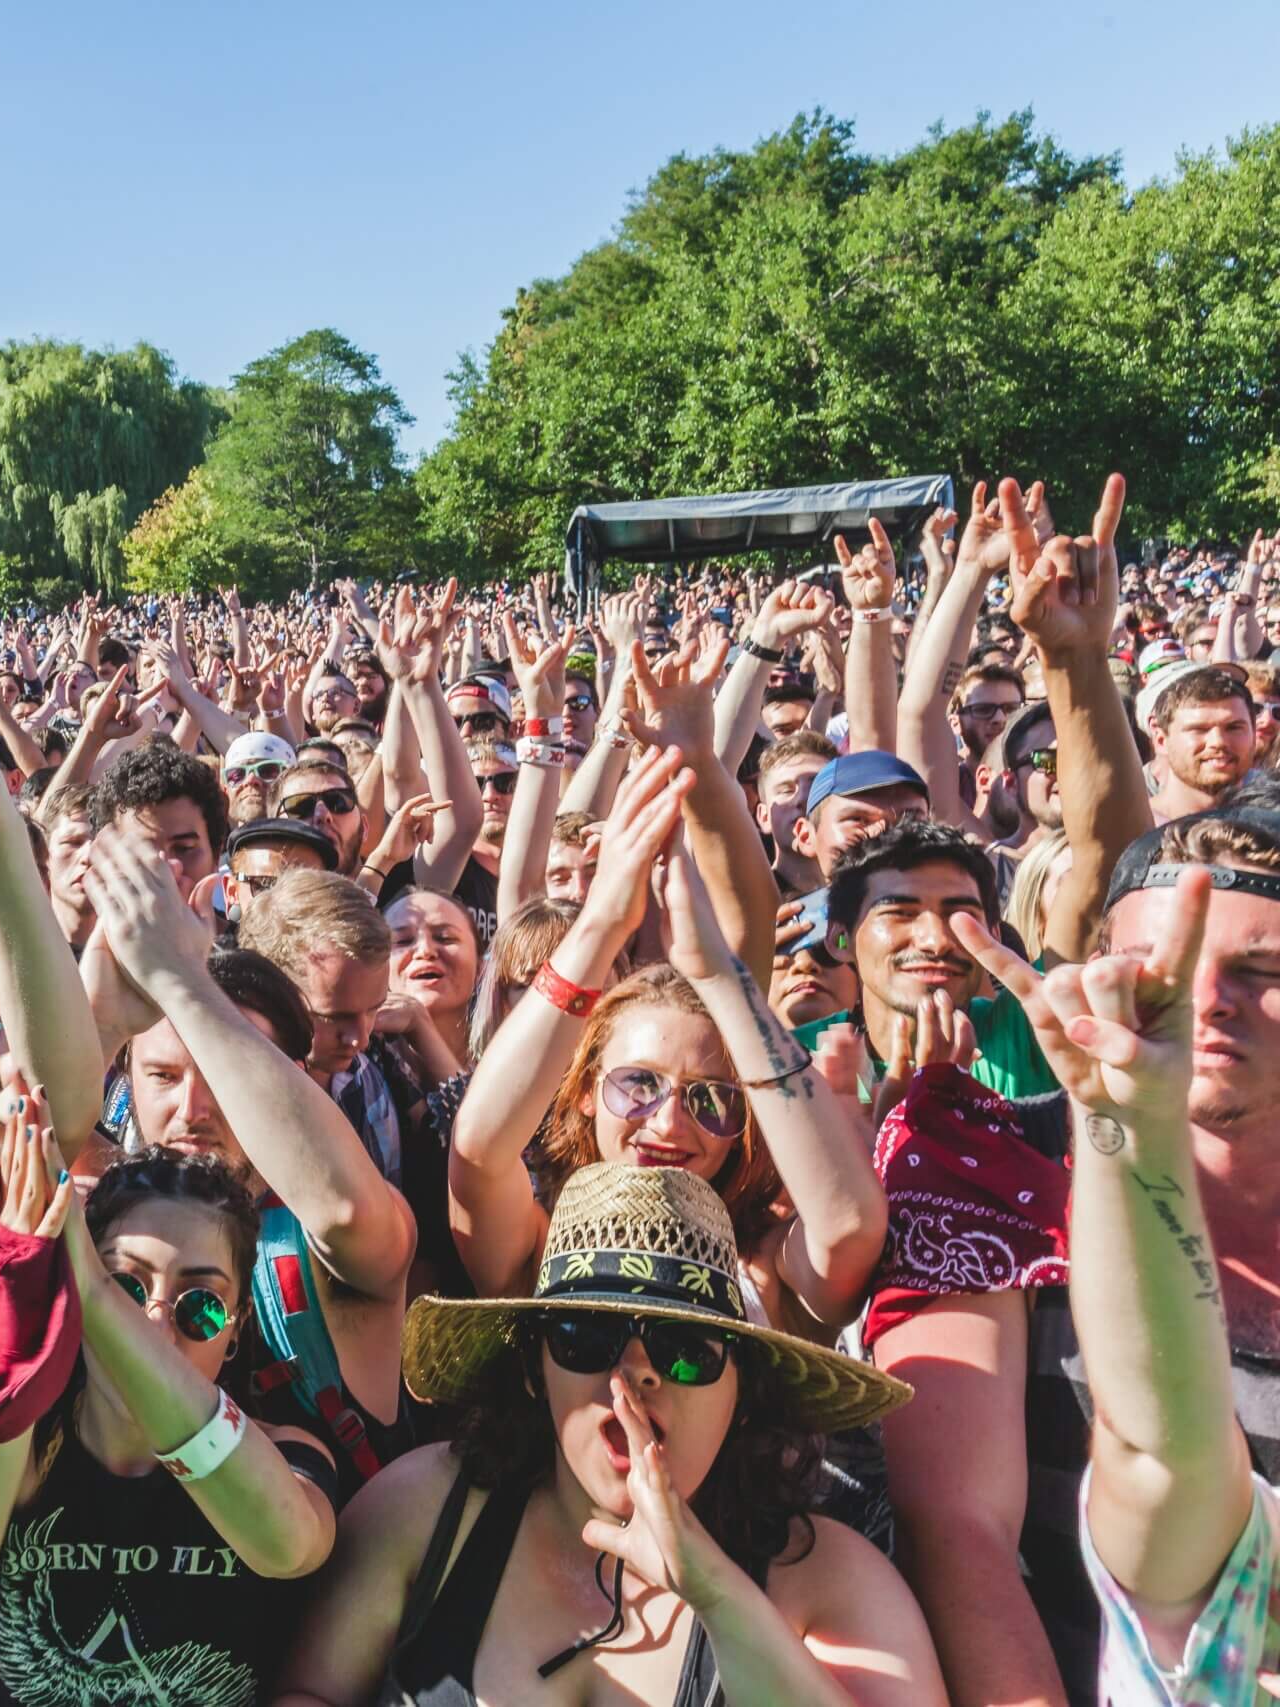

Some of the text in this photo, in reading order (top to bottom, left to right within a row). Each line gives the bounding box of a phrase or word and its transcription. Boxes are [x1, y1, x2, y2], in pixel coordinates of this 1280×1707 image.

[1, 1542, 241, 1578] BORN TO FLY
